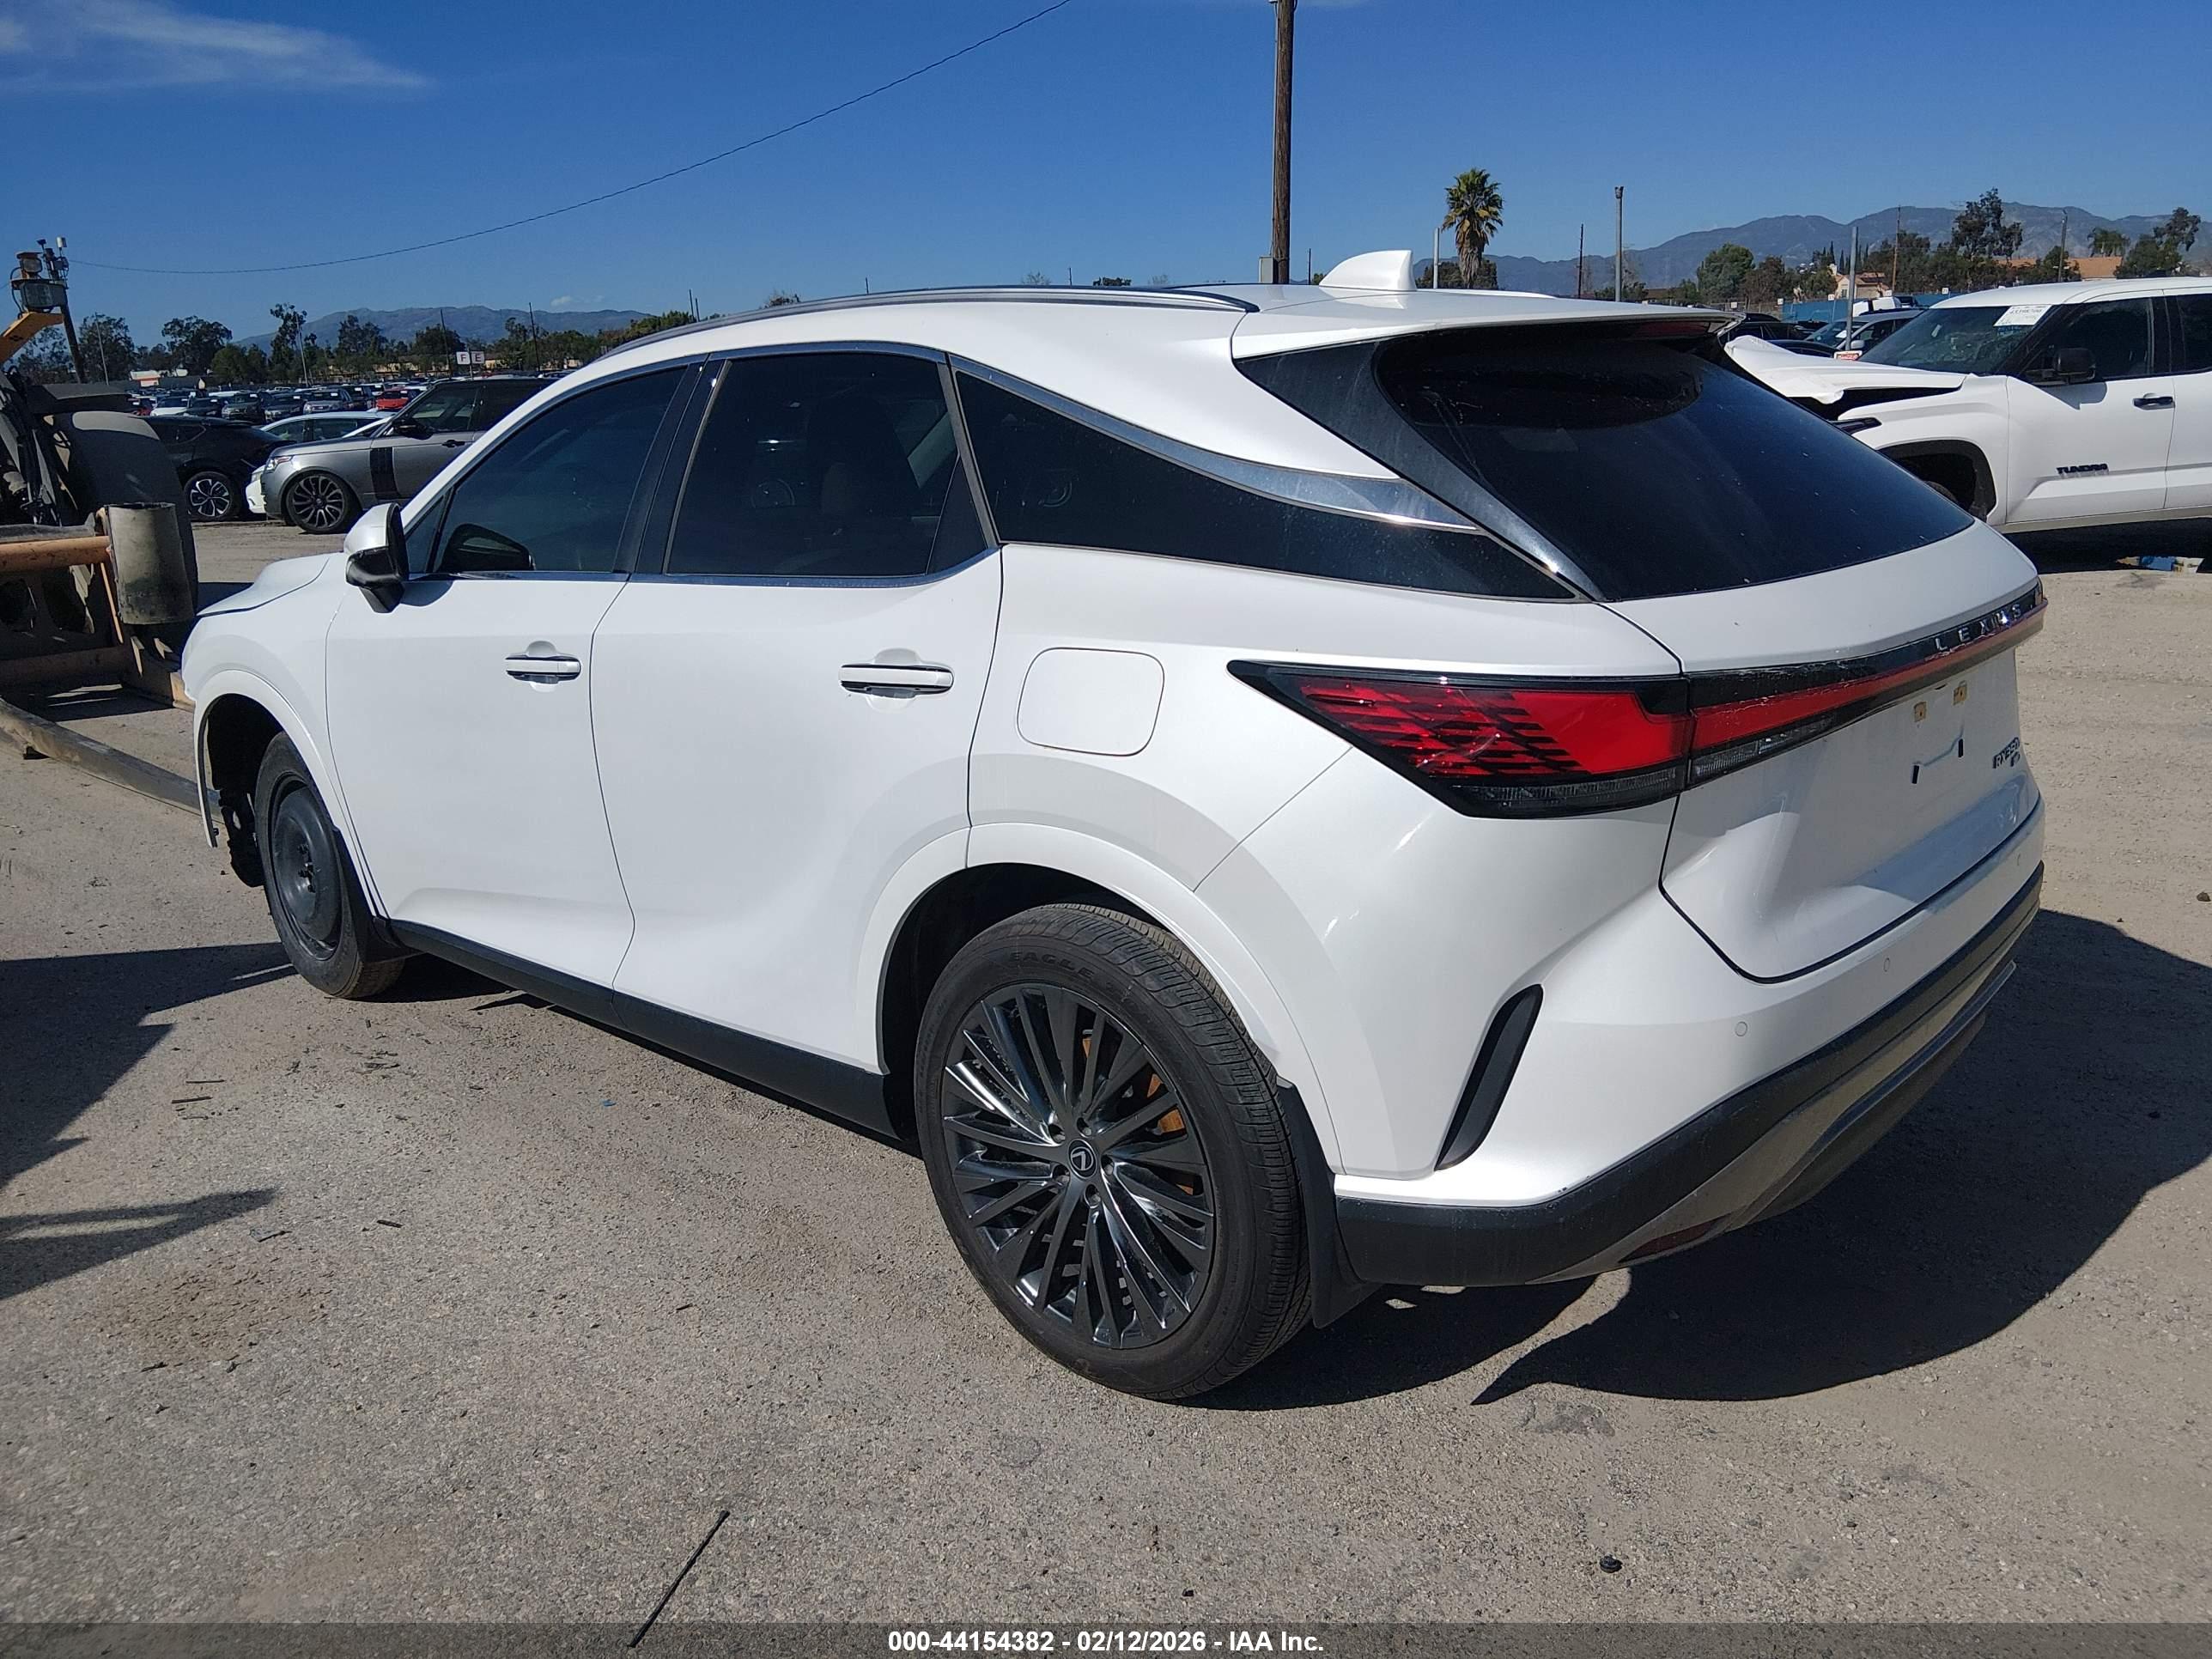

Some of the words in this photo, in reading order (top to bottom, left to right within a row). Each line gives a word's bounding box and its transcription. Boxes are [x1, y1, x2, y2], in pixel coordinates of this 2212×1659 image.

[475, 353, 482, 362] E
[2056, 463, 2108, 474] TUNDRA
[1935, 603, 2021, 651] LEXUS
[1009, 951, 1095, 980] EAGLE
